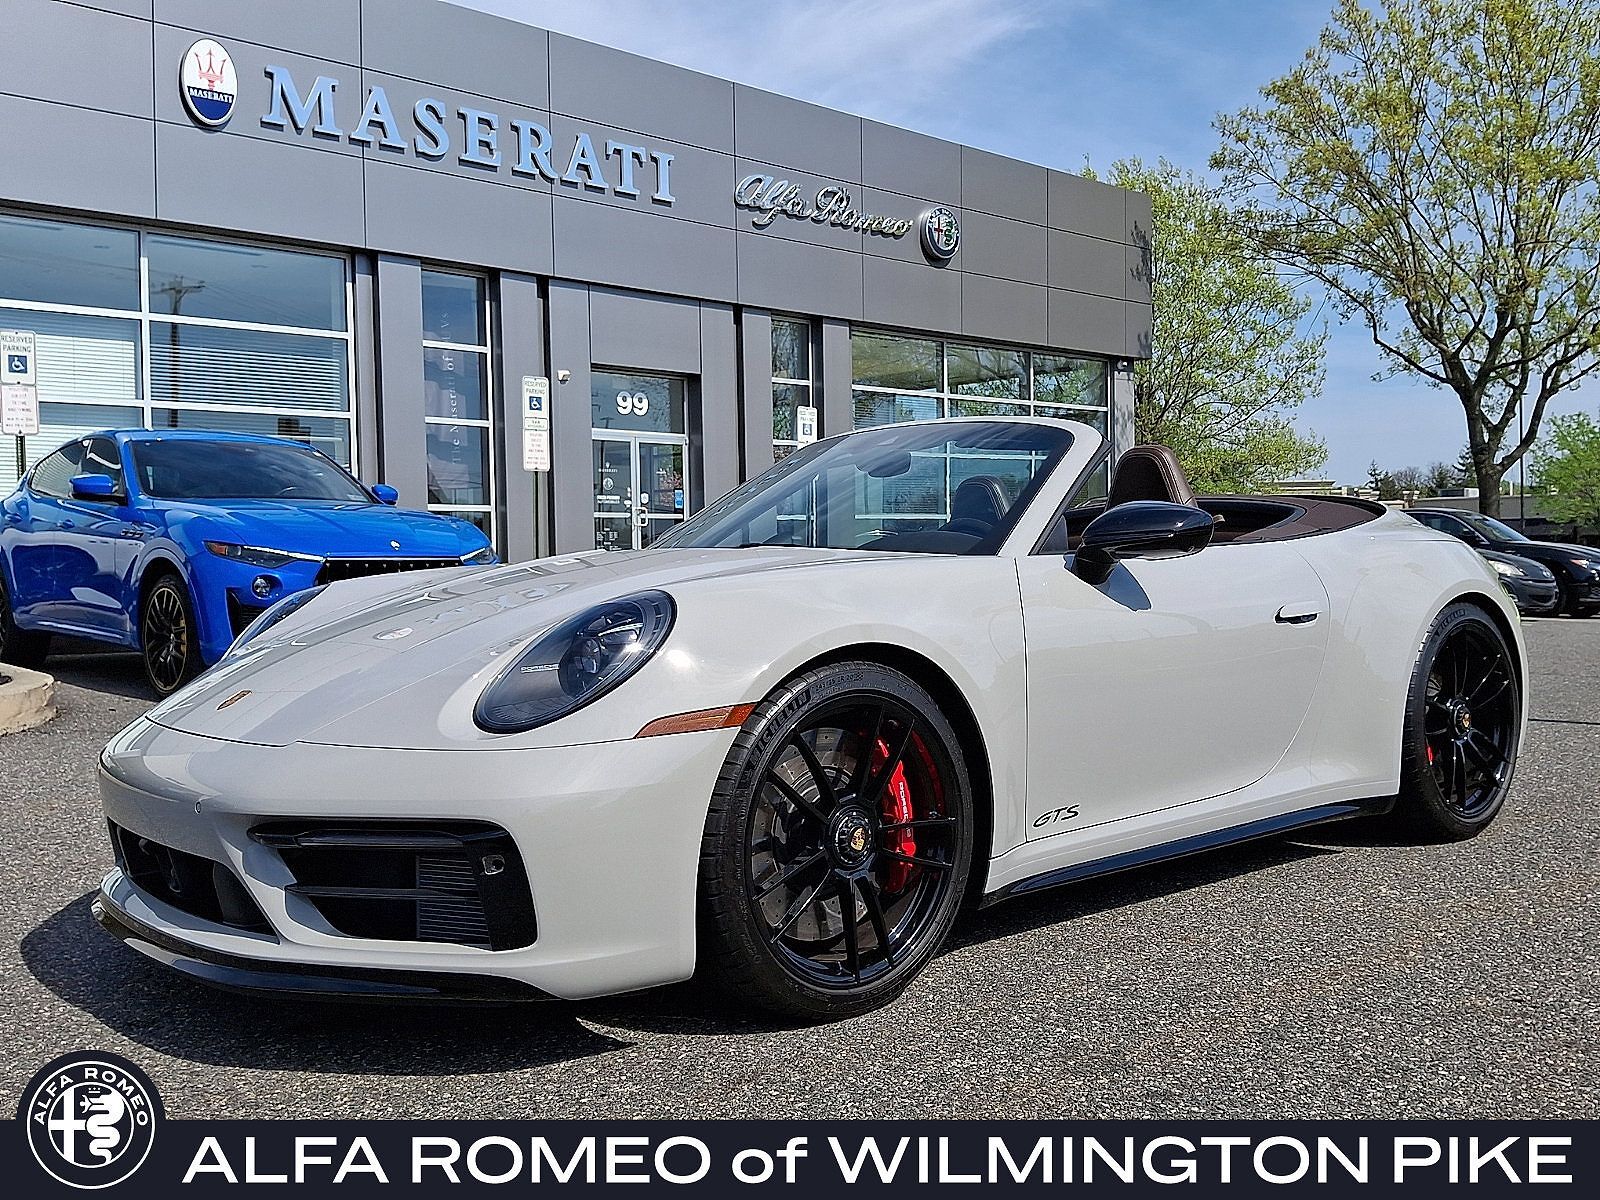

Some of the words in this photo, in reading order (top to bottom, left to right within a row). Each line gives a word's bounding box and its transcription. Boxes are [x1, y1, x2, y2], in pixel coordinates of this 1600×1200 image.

[188, 87, 233, 104] MASERATI
[260, 64, 676, 206] MASERATI
[735, 174, 811, 229] Alfa
[811, 186, 913, 238] Romeo
[442, 355, 454, 371] of
[616, 391, 649, 416] 99
[899, 781, 912, 838] PORSCE
[1032, 804, 1080, 828] GTS
